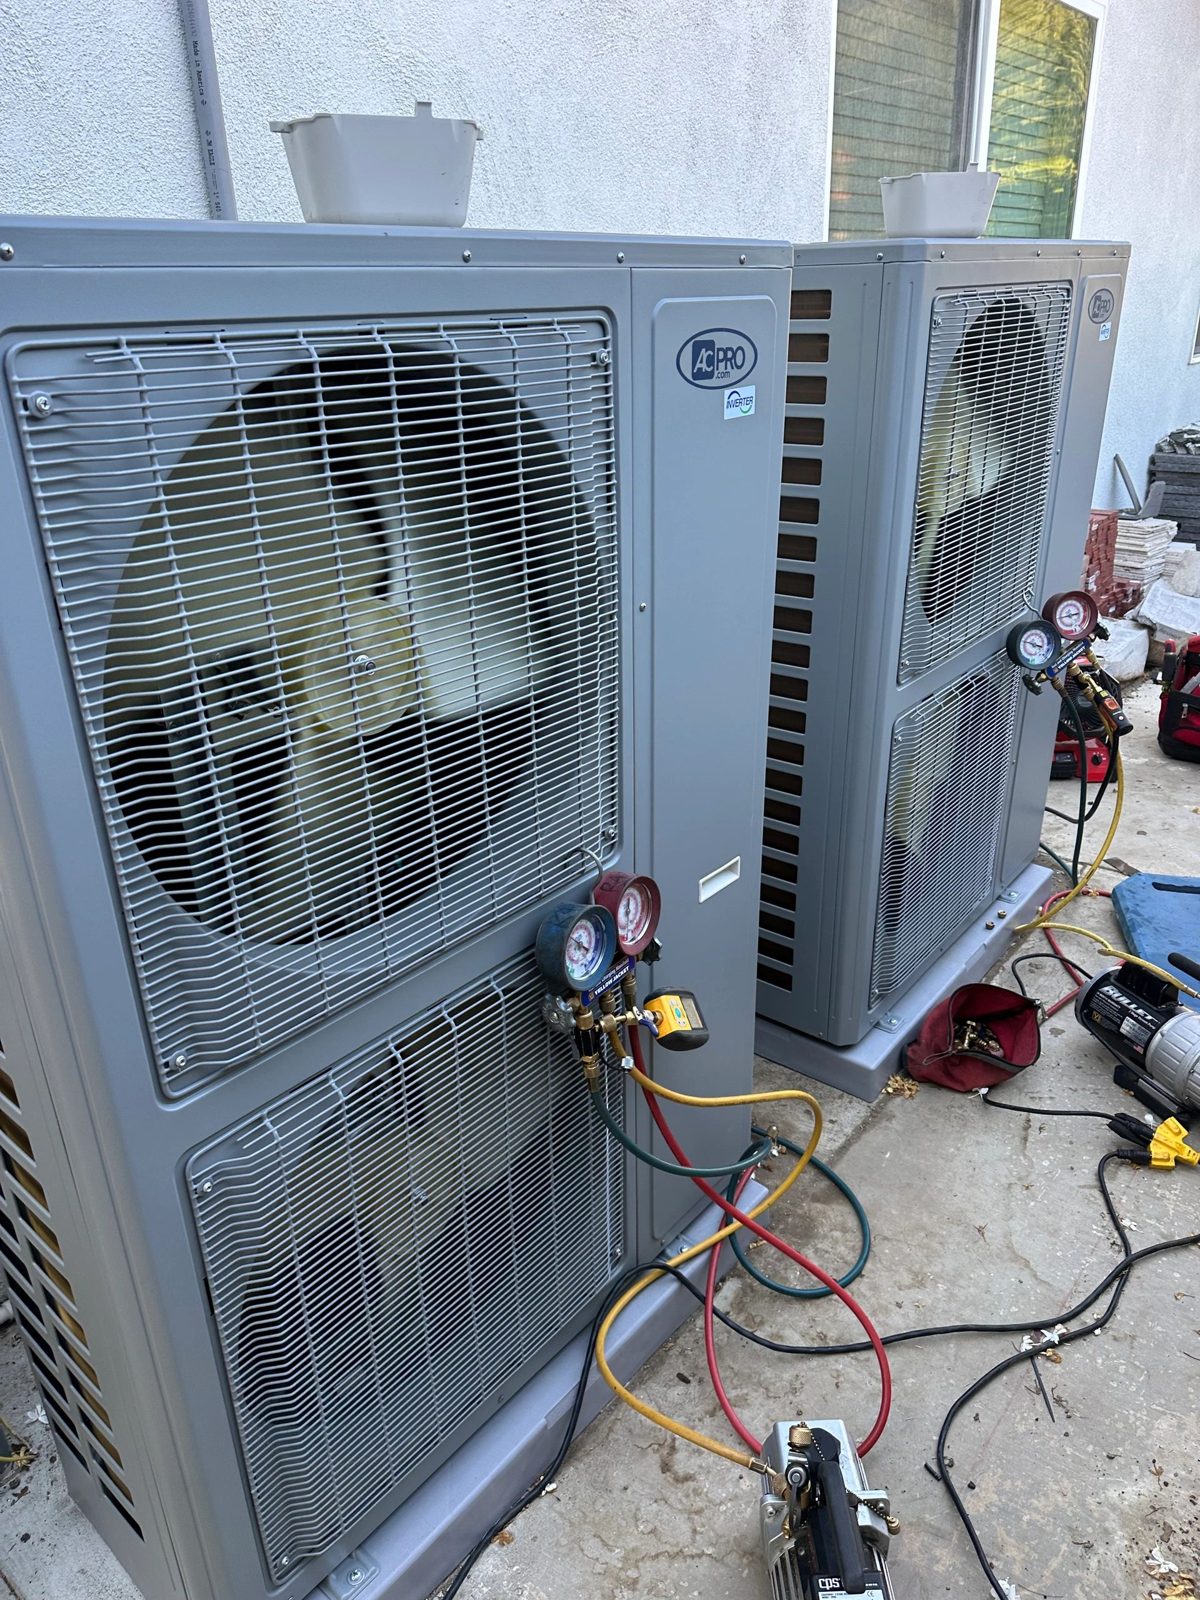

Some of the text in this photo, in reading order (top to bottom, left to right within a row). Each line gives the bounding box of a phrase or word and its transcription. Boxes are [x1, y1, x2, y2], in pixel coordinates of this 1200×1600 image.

[716, 345, 746, 371] PRO
[715, 370, 731, 379] .com
[726, 395, 754, 409] INVERTER
[594, 979, 613, 995] YELLOW
[613, 965, 630, 981] JACKET
[1098, 984, 1159, 1023] BULLET
